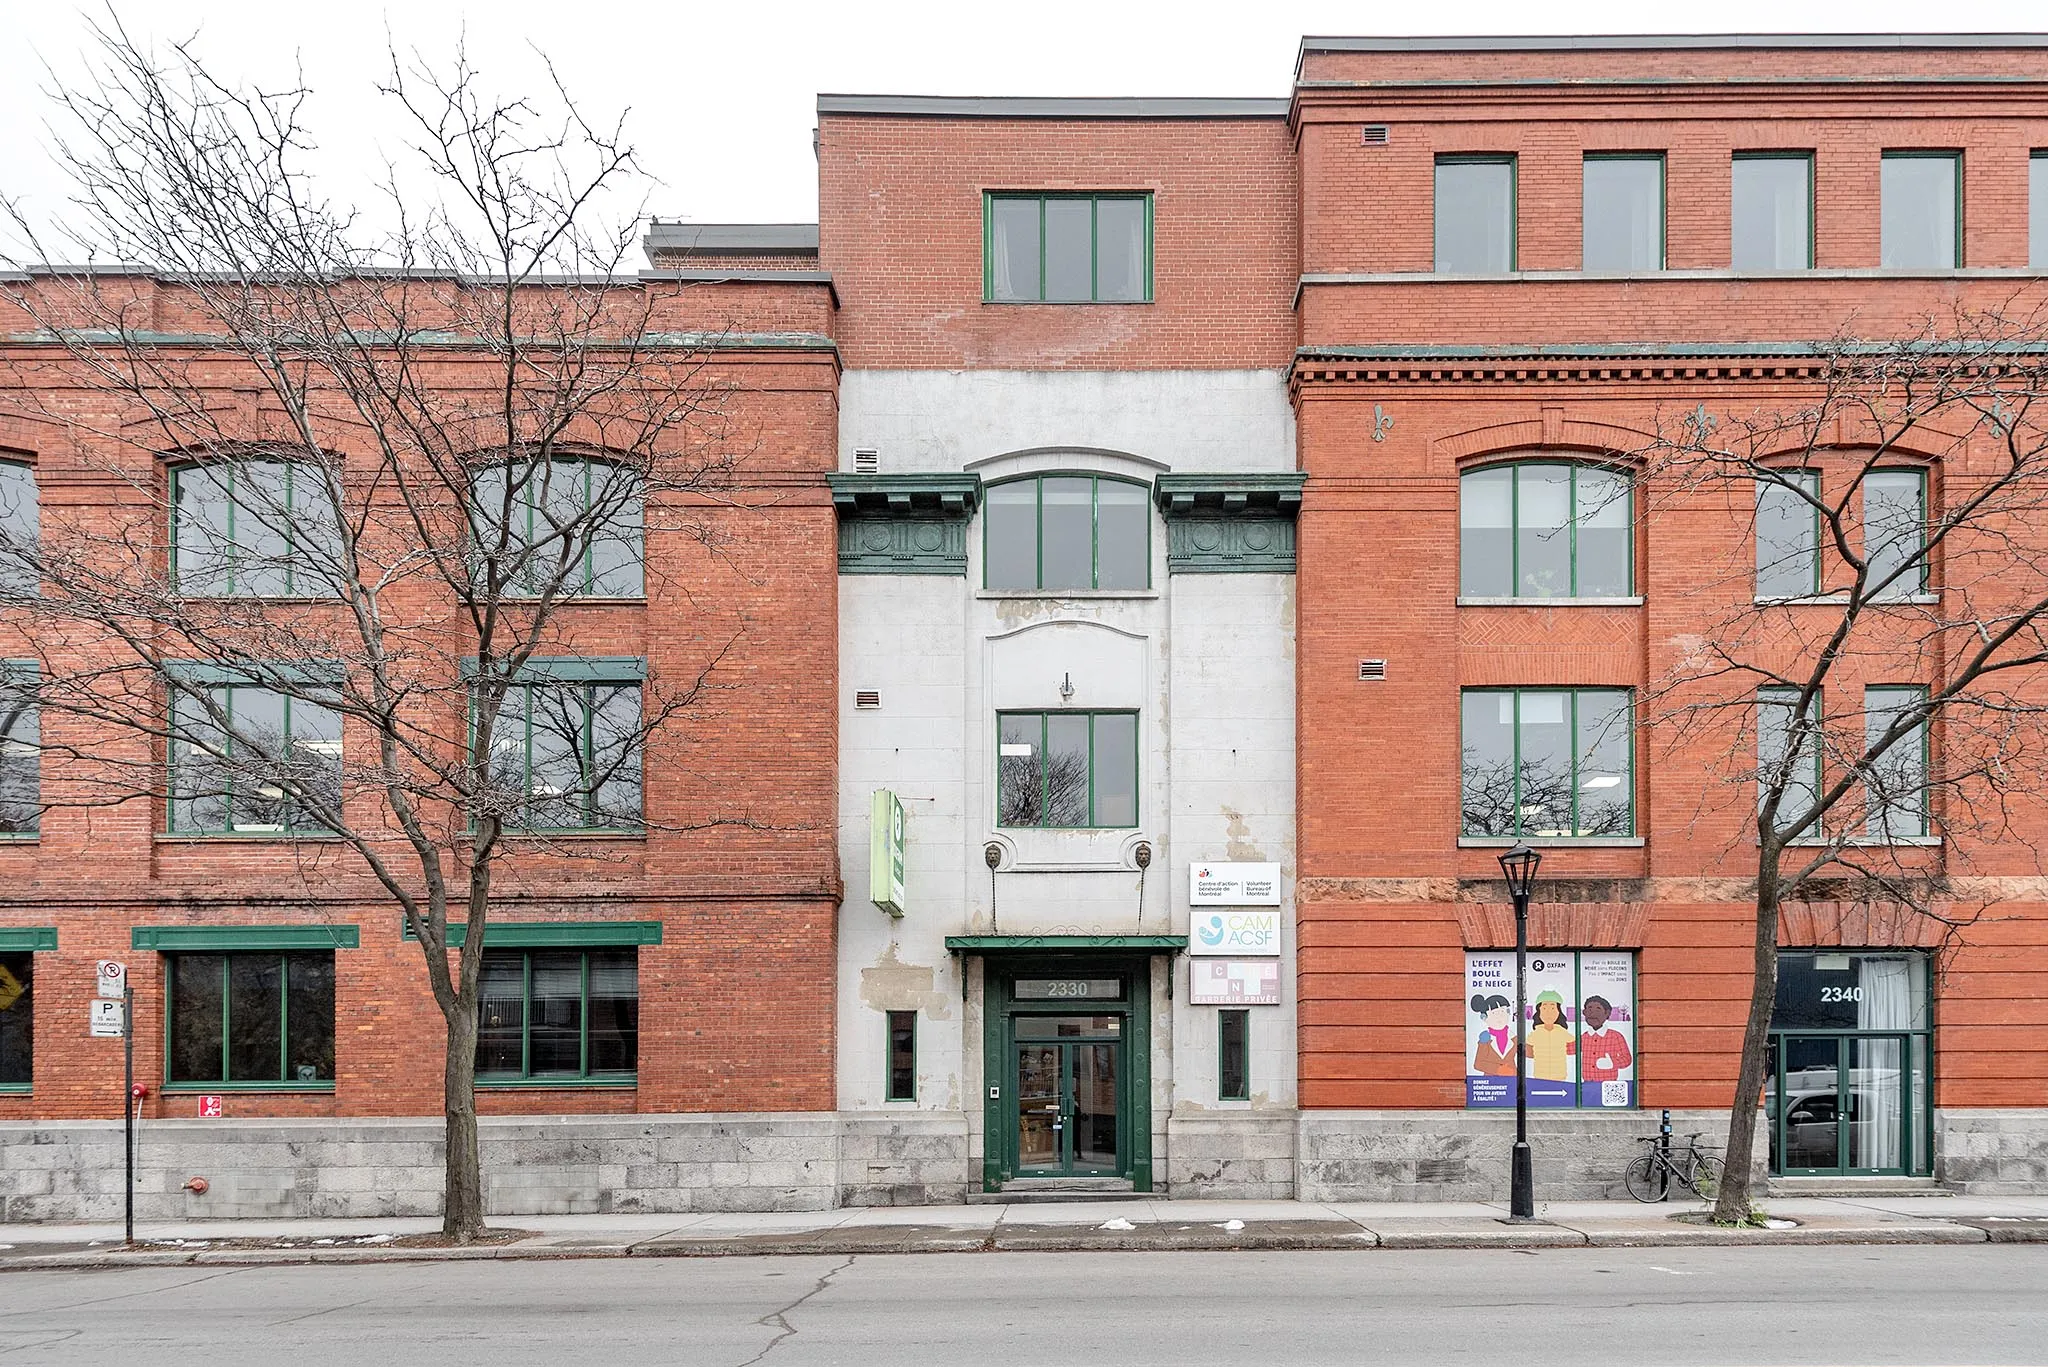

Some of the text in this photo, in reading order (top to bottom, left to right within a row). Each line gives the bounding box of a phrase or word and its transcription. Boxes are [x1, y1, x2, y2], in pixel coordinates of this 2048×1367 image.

[1228, 915, 1273, 931] CAM
[1228, 930, 1273, 946] ACSF
[1472, 960, 1503, 968] L'EFFET
[1472, 970, 1501, 978] BOULE
[1047, 982, 1088, 996] 2330
[1472, 980, 1512, 988] DE NEIGE
[1194, 995, 1241, 1003] GARDERIE
[1820, 986, 1863, 1002] 2340
[103, 1003, 113, 1014] P
